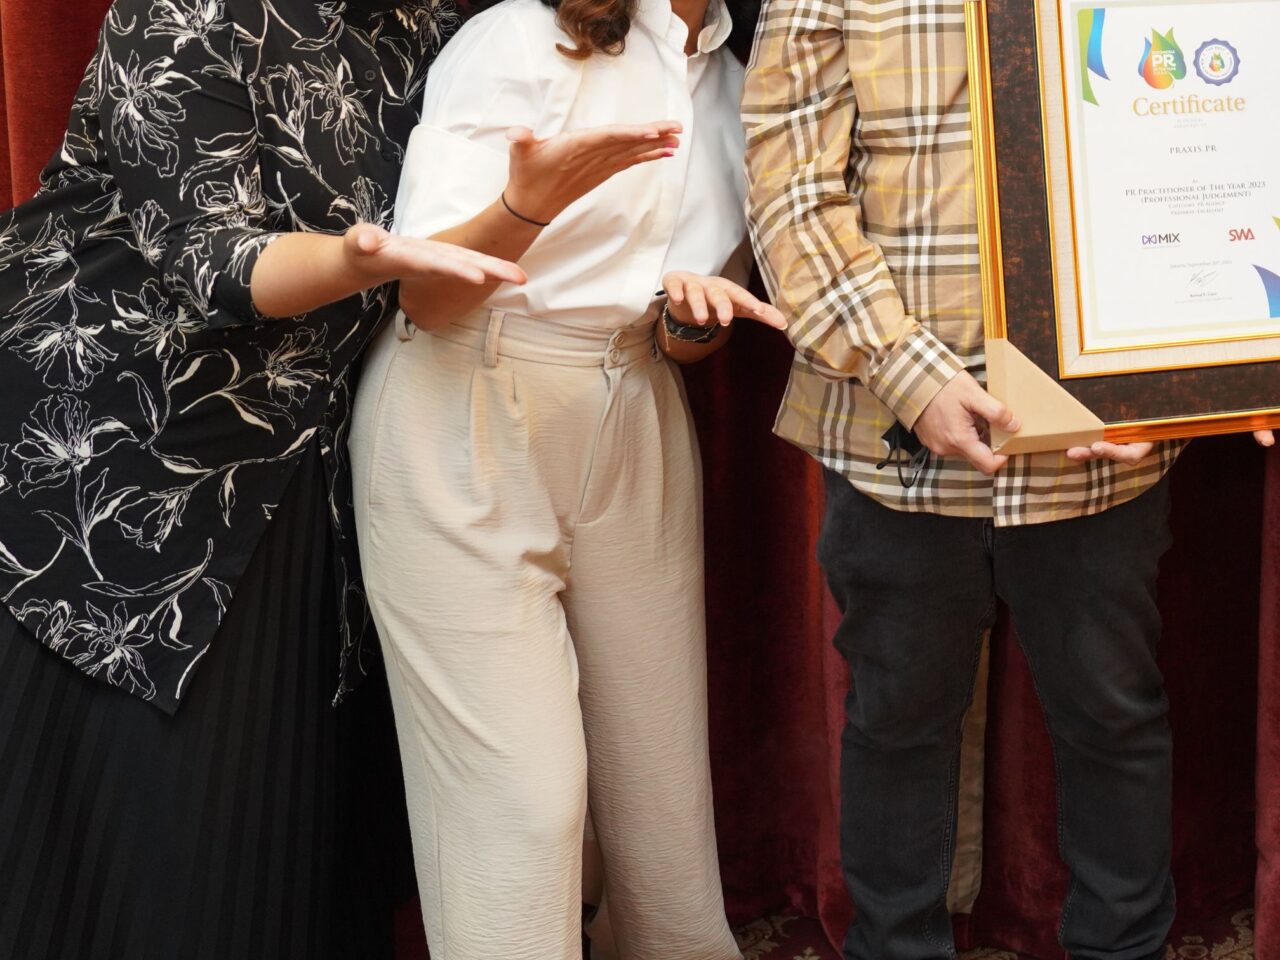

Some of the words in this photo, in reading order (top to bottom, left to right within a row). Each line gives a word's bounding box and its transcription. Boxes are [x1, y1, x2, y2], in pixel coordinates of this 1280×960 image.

[1133, 93, 1245, 117] Certificate
[1169, 145, 1202, 155] PRAXIS
[1205, 144, 1217, 153] PR
[1125, 188, 1136, 197] PR
[1229, 227, 1255, 242] SWA
